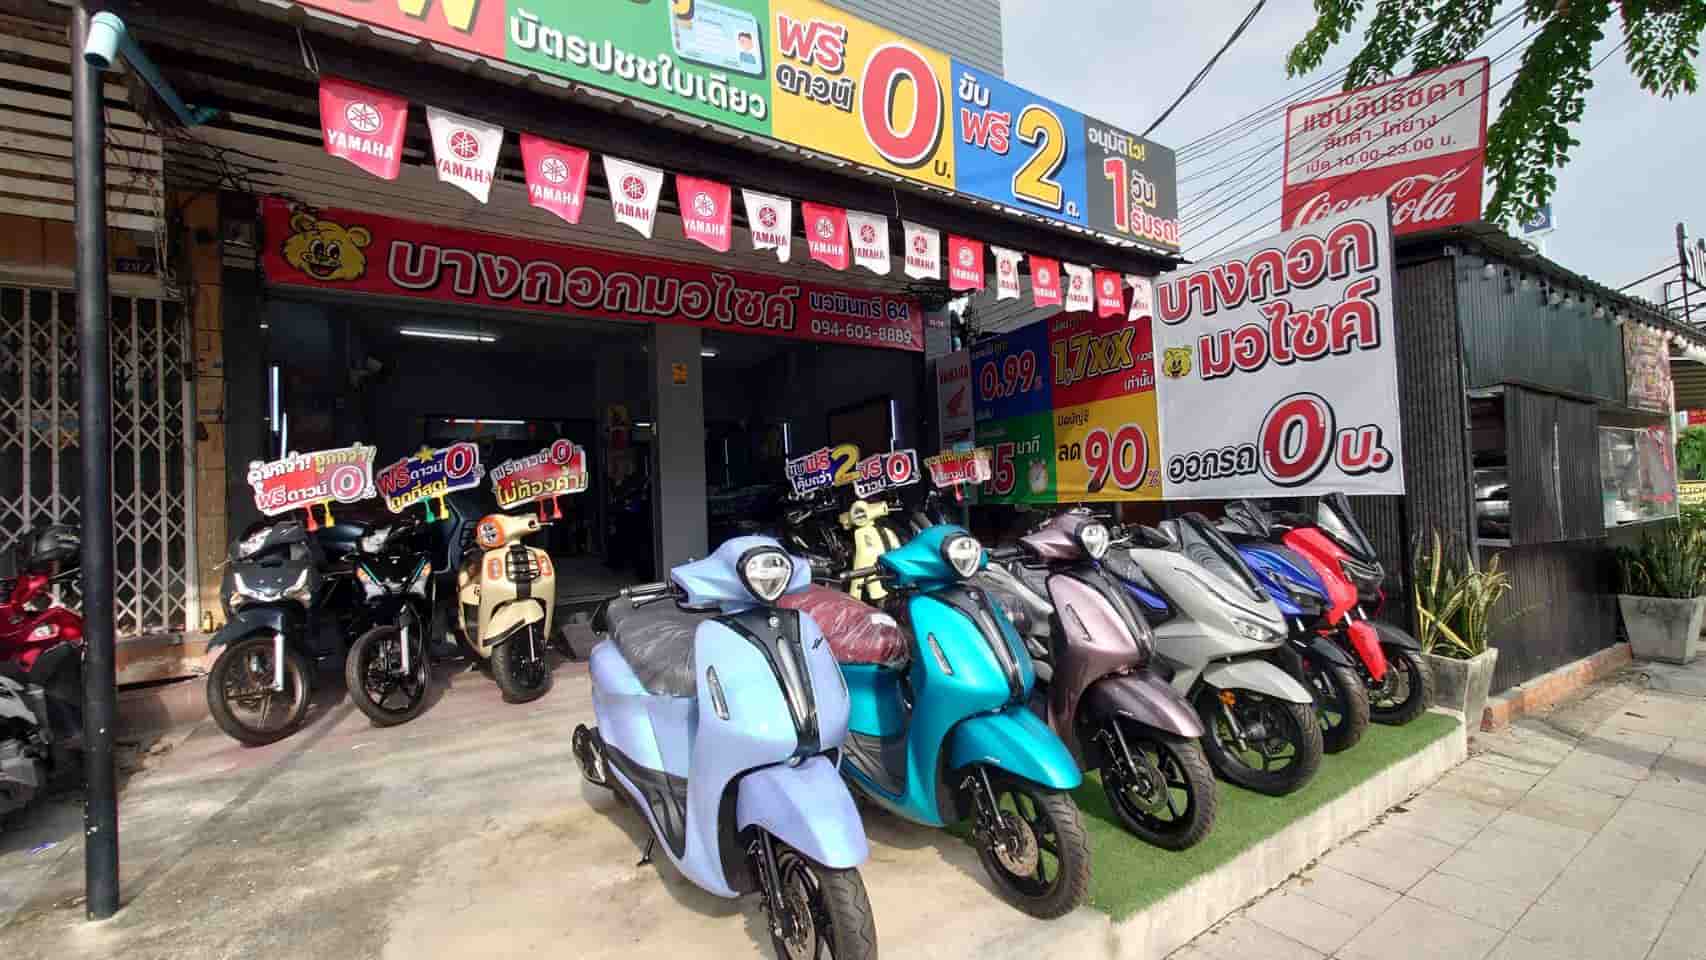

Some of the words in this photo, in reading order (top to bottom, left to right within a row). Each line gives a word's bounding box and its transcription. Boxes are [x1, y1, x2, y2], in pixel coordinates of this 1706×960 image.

[777, 14, 846, 73] ฟรี
[510, 11, 768, 120] บัตรปชชใบเดียว
[958, 71, 990, 107] ขับ
[776, 62, 854, 112] ดาวน์
[858, 42, 943, 169] 0
[934, 156, 952, 180] บ.
[326, 129, 394, 161] YAMAHA
[960, 108, 1012, 155] ฟรี
[1012, 103, 1066, 212] 2
[1088, 127, 1146, 162] อนุมัติไว!
[529, 183, 580, 206] YAMAHA
[614, 200, 652, 221] YAMAH
[1103, 157, 1128, 233] 1
[1130, 168, 1157, 208] วัน
[684, 218, 725, 236] YAMAHA
[752, 231, 788, 248] YAMAHA
[808, 239, 844, 257] YAMAHA
[854, 246, 886, 260] YAMAHA
[906, 255, 935, 270] YAMAHA
[387, 237, 799, 330] บางกอกมอไซค์
[1157, 218, 1382, 325] บางกอก
[886, 299, 909, 321] 64
[811, 318, 913, 345] 094-605-8889
[1198, 276, 1381, 380] มอไซค์
[551, 439, 574, 465] 0
[1015, 434, 1041, 454] นาที
[1058, 439, 1081, 461] ลด
[1083, 422, 1149, 493] 90
[1168, 443, 1258, 483] ออกรถ
[1258, 392, 1336, 488] 0
[1335, 424, 1394, 475] บ.
[444, 443, 475, 479] 0
[830, 442, 862, 488] 2
[886, 452, 911, 483] 0
[332, 465, 365, 501] 0
